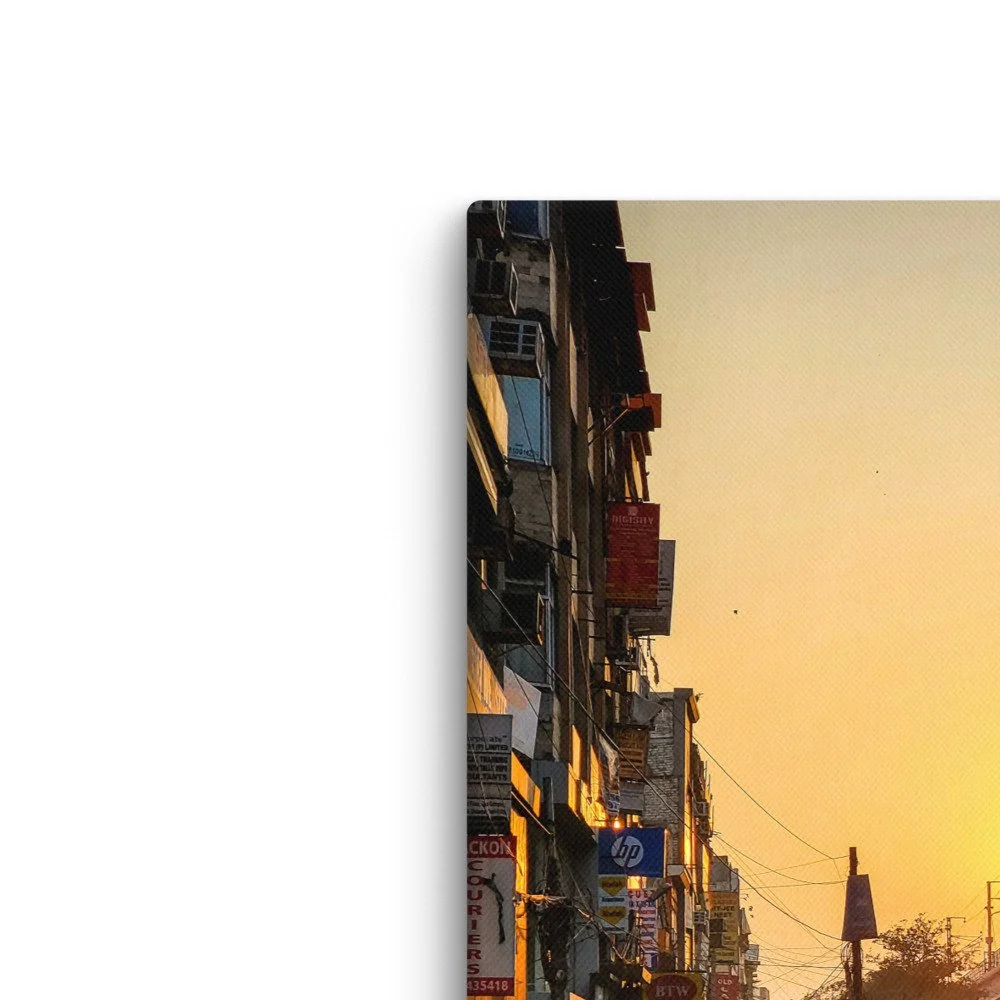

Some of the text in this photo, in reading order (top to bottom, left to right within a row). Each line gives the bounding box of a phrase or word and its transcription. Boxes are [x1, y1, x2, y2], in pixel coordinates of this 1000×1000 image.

[616, 836, 641, 868] hp
[467, 860, 483, 975] COURIERS
[655, 985, 690, 997] BTW
